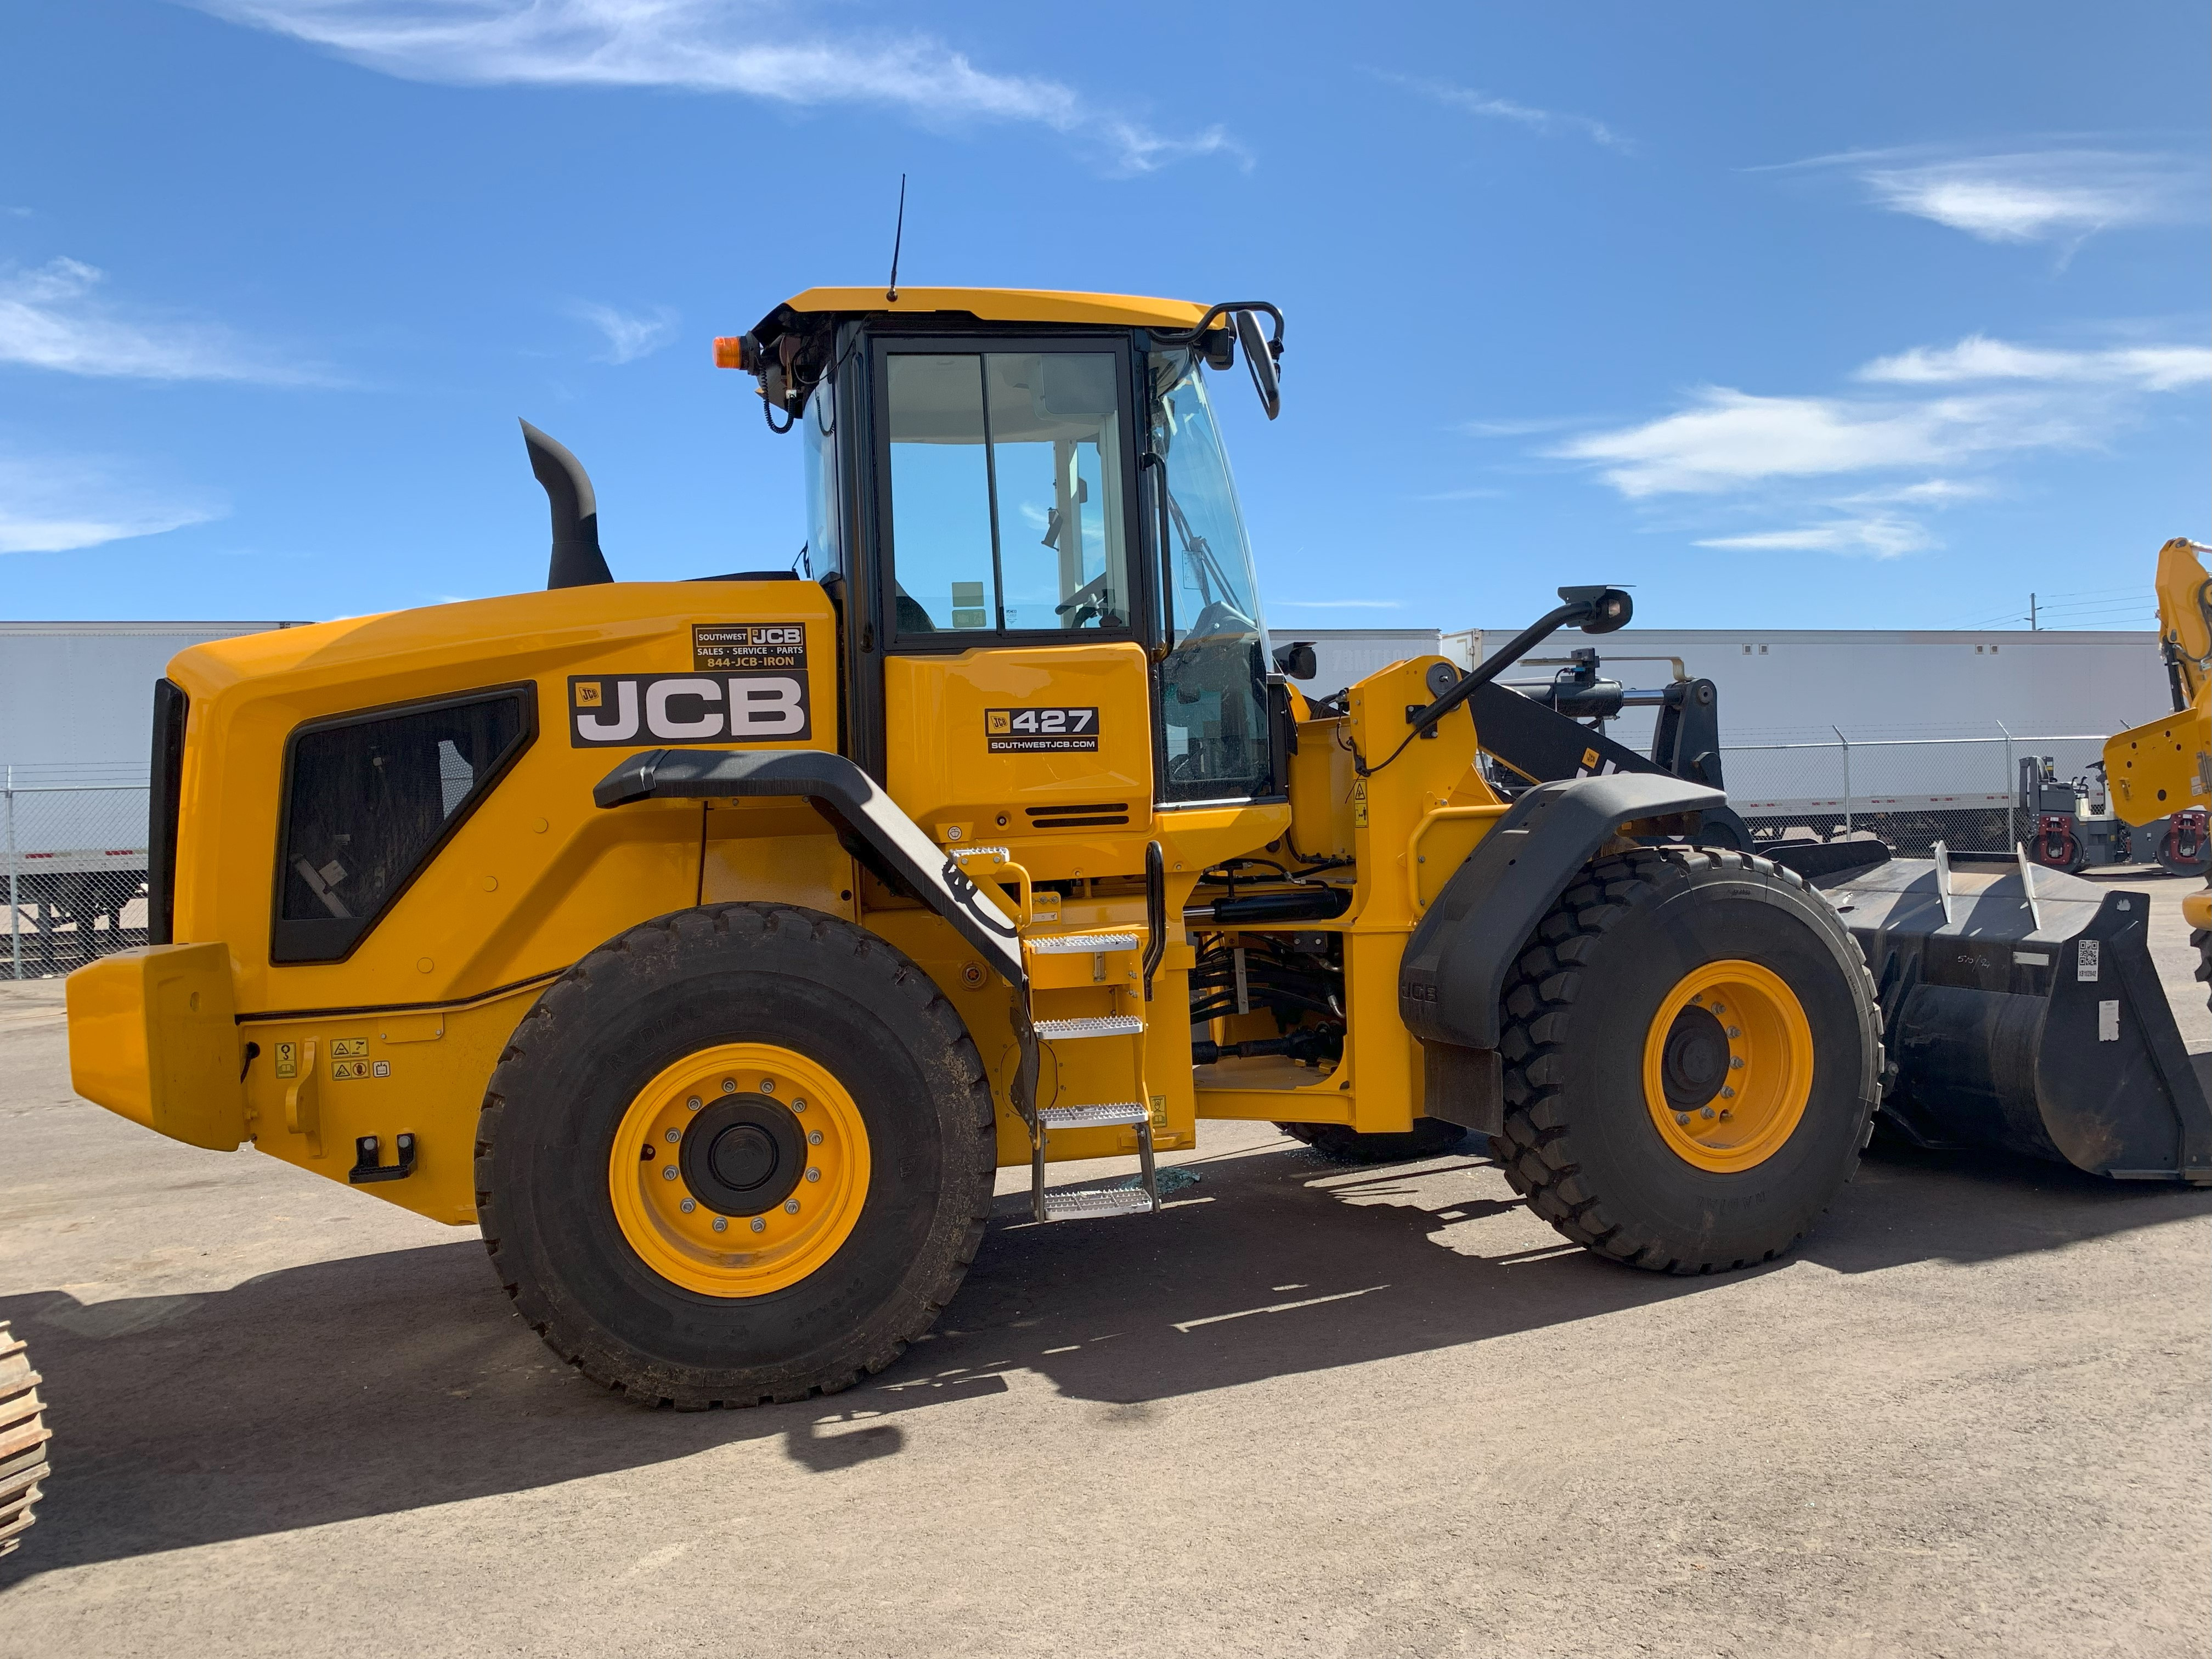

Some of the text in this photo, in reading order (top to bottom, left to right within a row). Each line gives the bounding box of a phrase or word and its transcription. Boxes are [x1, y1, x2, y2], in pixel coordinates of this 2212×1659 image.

[752, 629, 801, 644] JCB
[777, 646, 803, 654] PARTS
[707, 656, 794, 668] 844-JCB-IRON
[582, 688, 599, 701] JCB
[577, 676, 805, 741] JCB
[994, 710, 1093, 733] JCB 427
[991, 741, 1095, 749] SOUTHWESTJCB.COM
[1402, 982, 1438, 1004] JCB
